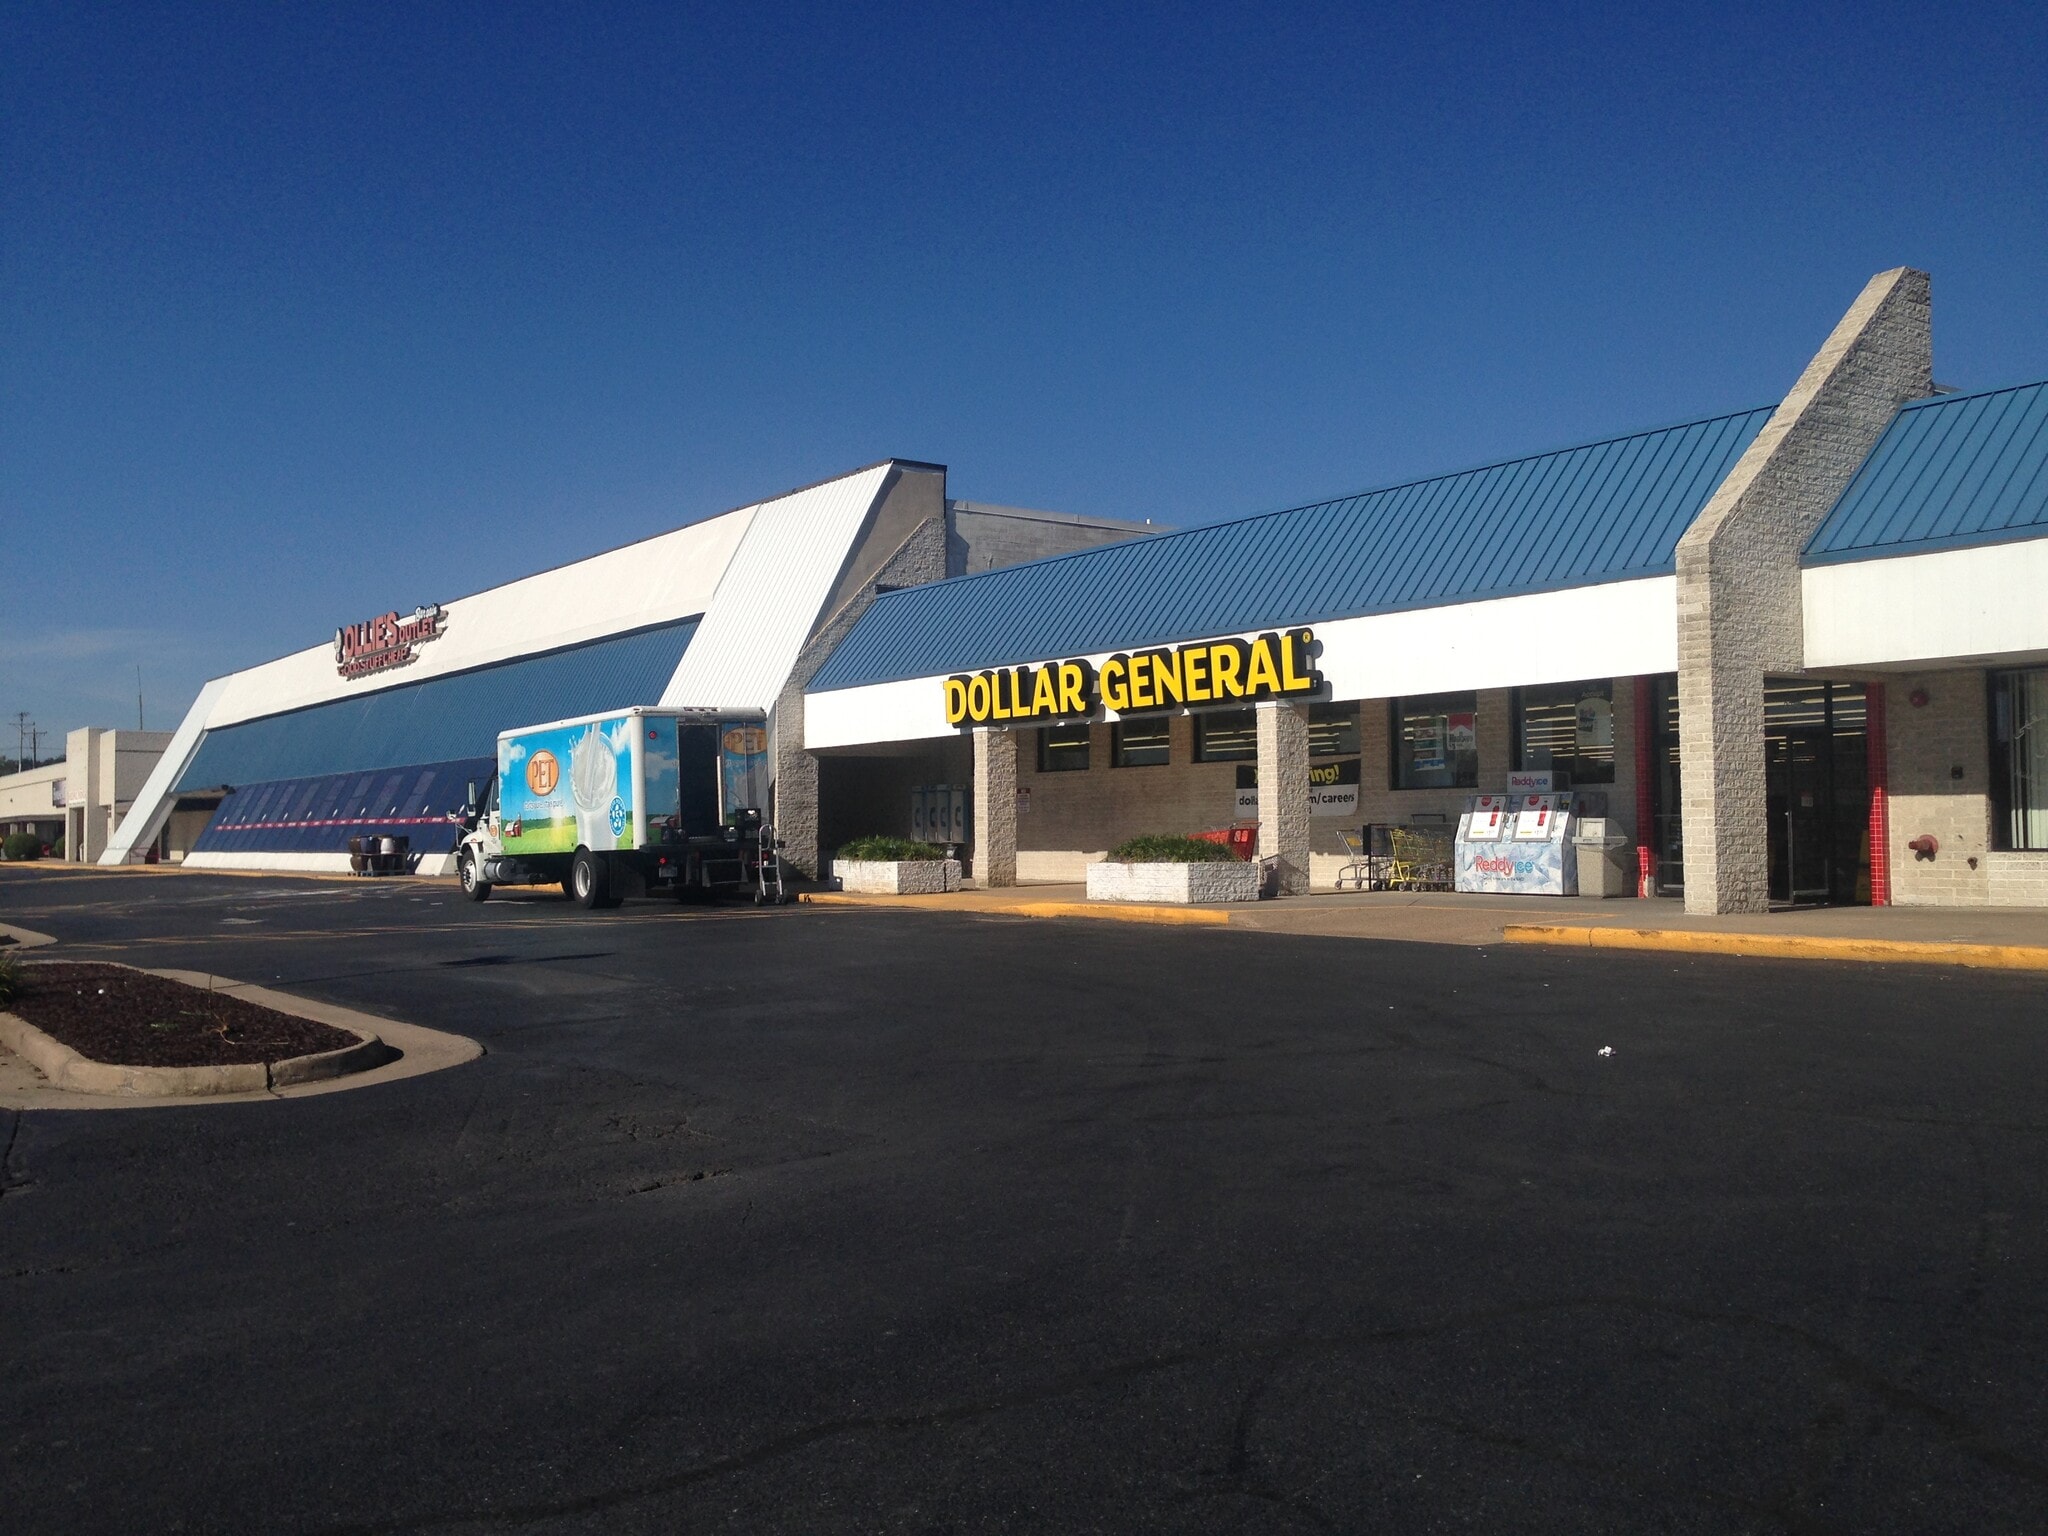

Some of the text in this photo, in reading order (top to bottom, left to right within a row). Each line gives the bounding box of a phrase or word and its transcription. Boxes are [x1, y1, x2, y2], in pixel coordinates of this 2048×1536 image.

[344, 611, 435, 658] OLLIE'S OUTLET
[338, 648, 408, 677] GOOD STUFF CHEAP
[943, 635, 1311, 724] DOLLAR GENERAL
[530, 759, 555, 790] PET
